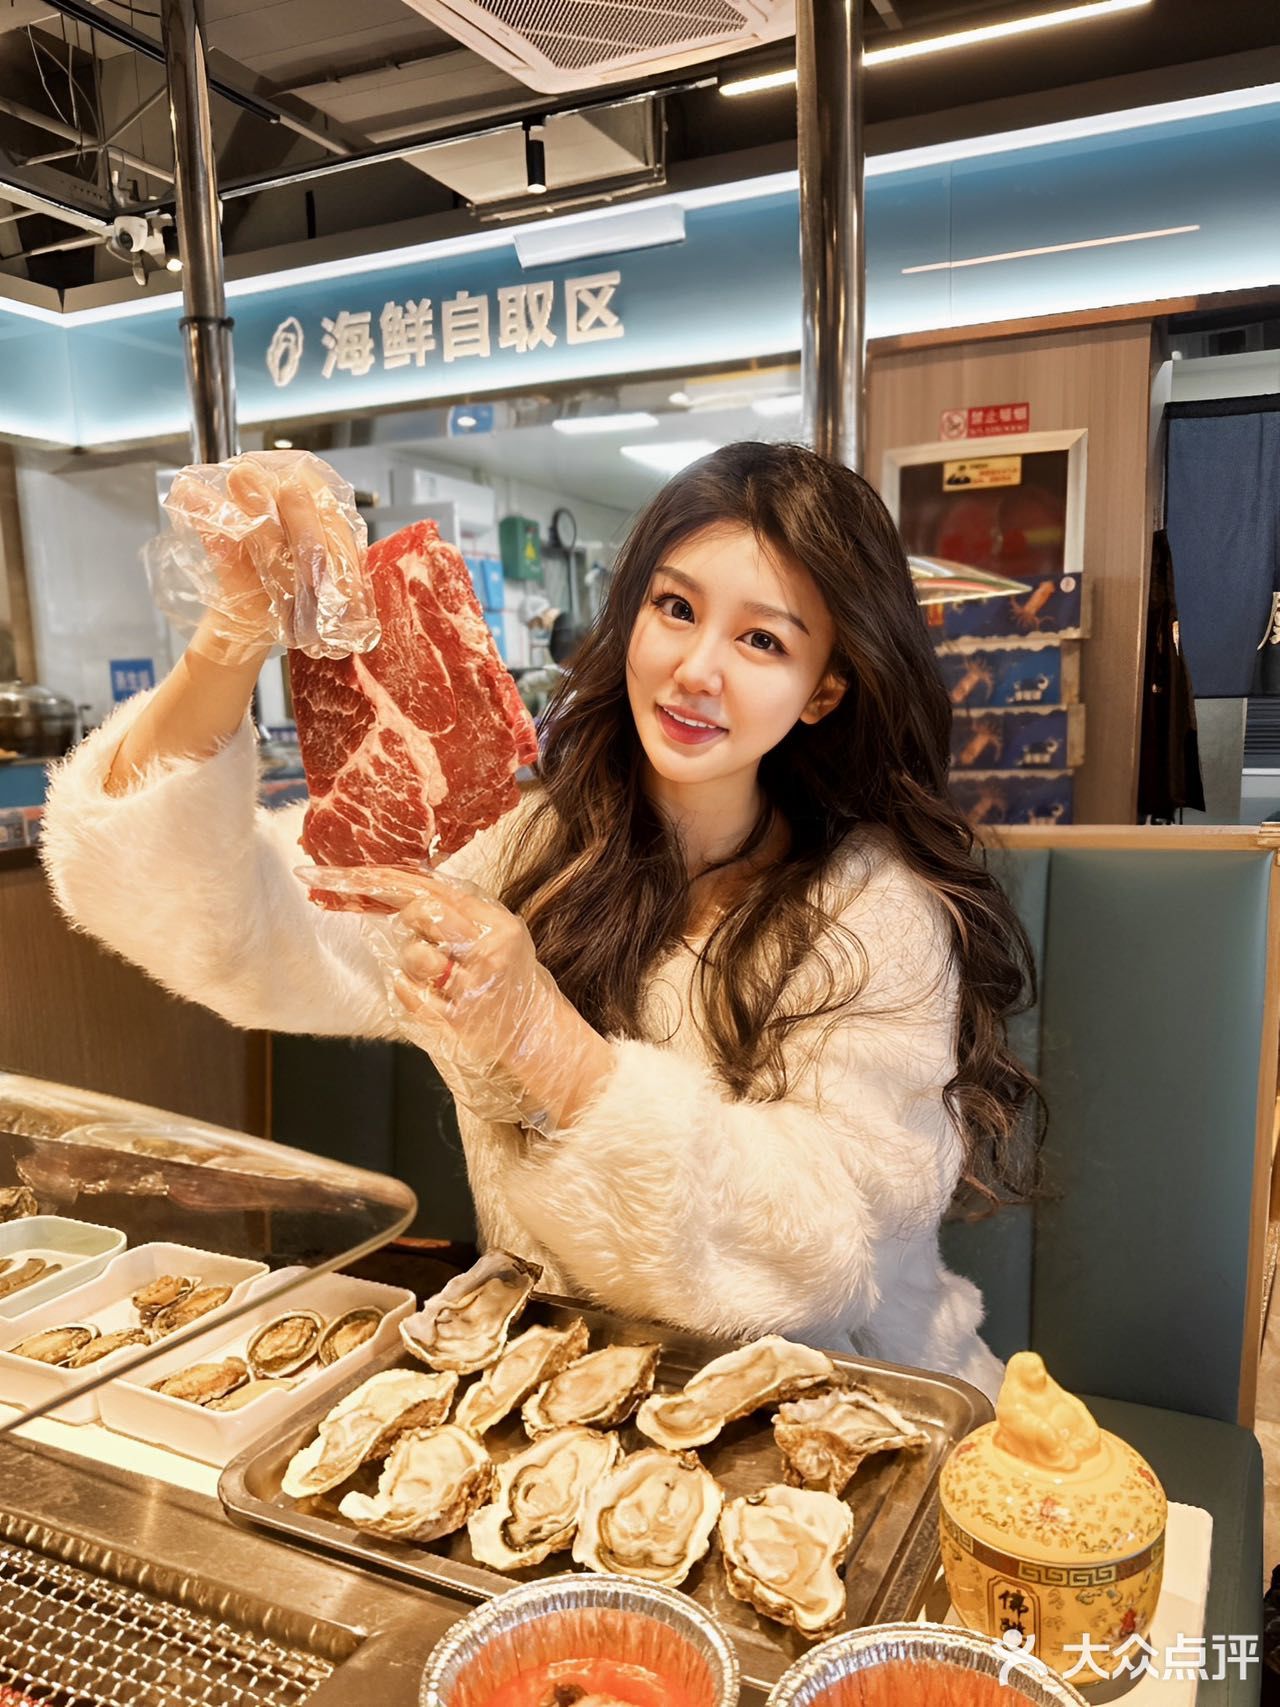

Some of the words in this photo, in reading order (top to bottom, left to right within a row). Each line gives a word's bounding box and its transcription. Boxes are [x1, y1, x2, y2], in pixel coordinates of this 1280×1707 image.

[320, 271, 625, 379] 海鲜自取区
